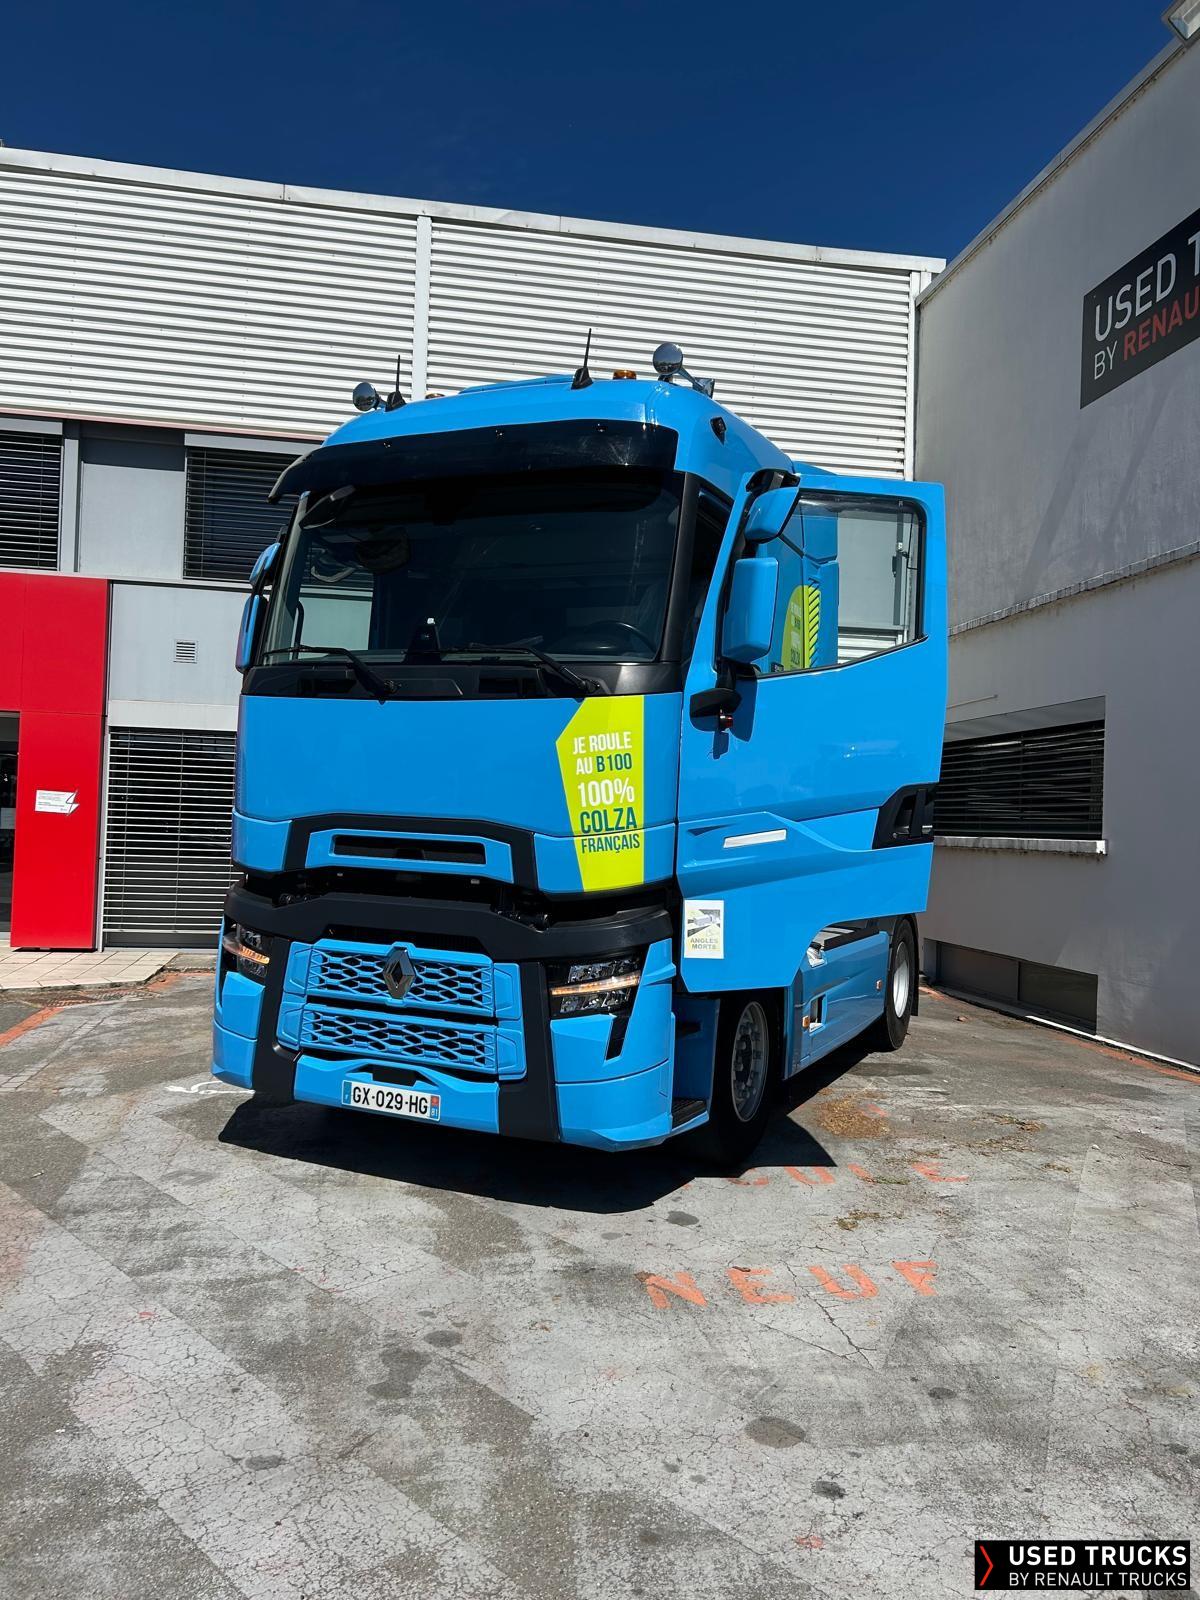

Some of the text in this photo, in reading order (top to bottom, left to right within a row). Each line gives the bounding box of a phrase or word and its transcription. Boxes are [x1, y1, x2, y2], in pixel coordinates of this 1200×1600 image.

[1095, 253, 1177, 342] USED
[1094, 340, 1118, 380] BY
[573, 731, 632, 755] JE ROULE
[576, 753, 633, 775] AU B100
[578, 777, 635, 808] 100%
[580, 807, 638, 834] COLZA
[581, 833, 640, 854] FRANÇAIS
[353, 1086, 428, 1114] GX-029-HG
[645, 1260, 939, 1309] NEUF
